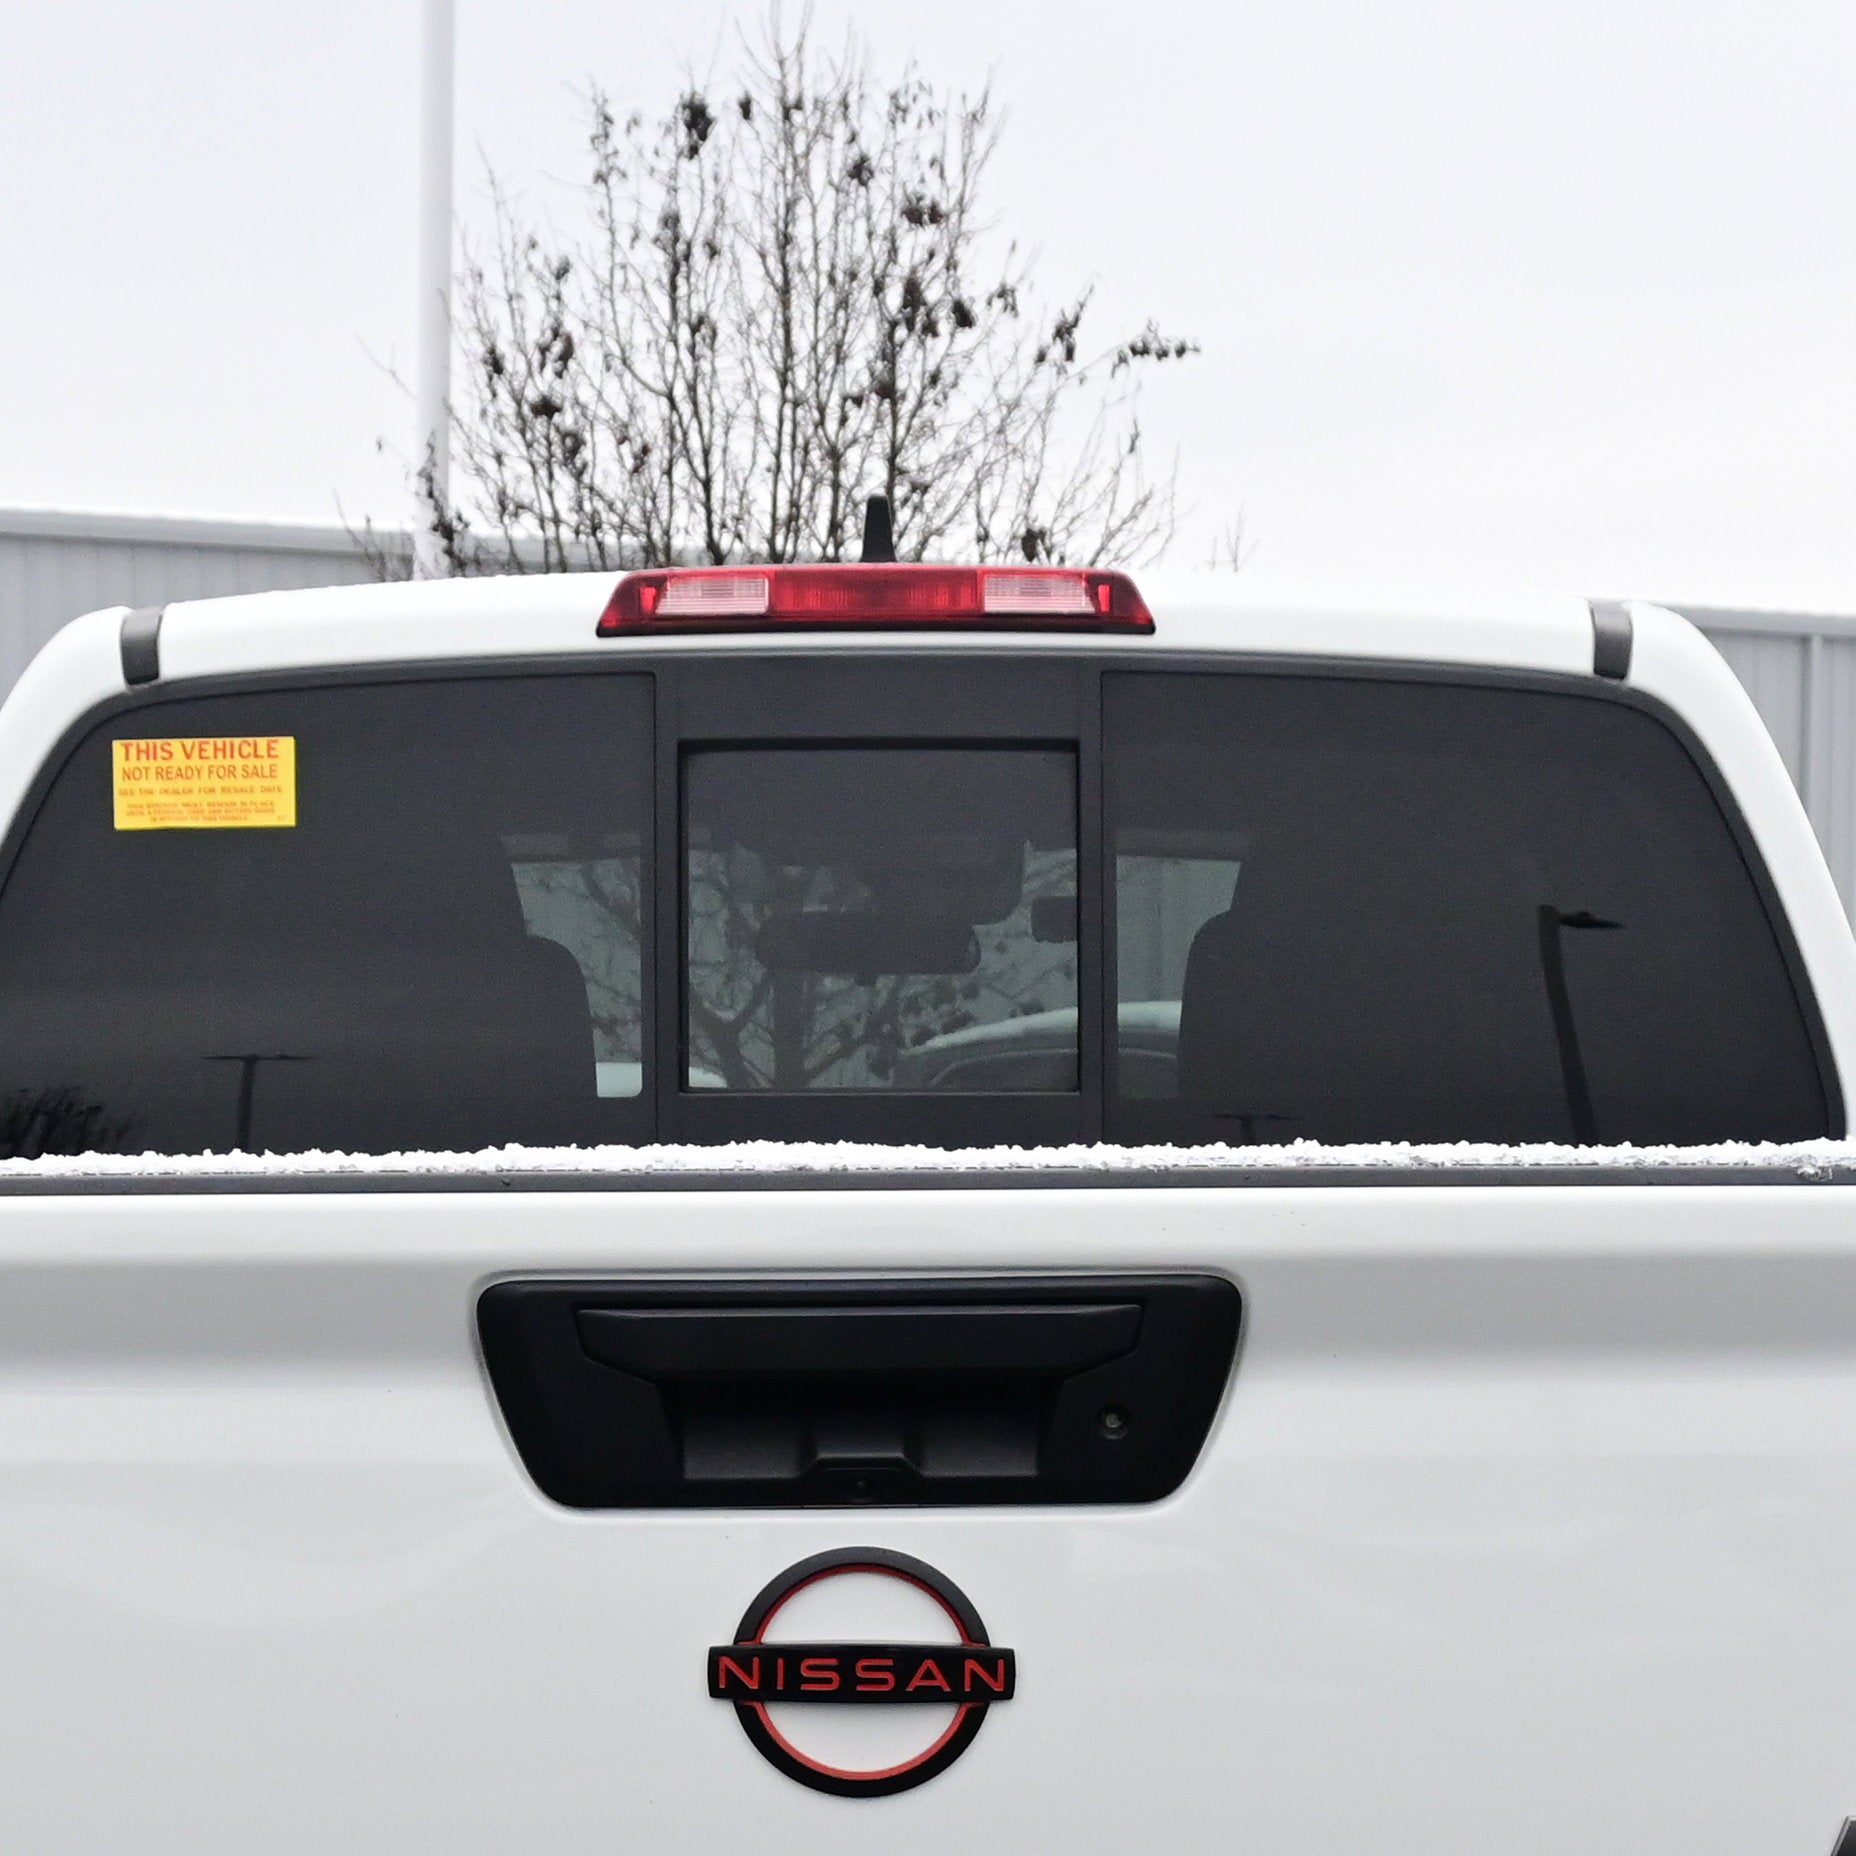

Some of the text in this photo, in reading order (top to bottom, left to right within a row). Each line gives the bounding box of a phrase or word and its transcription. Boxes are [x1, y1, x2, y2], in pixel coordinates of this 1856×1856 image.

[120, 739, 280, 762] THIS VEHICLE
[121, 763, 278, 781] NOT READY FOR SALE
[198, 786, 216, 795] FOR
[260, 784, 283, 794] DATE
[717, 1655, 1006, 1693] NISSAN
